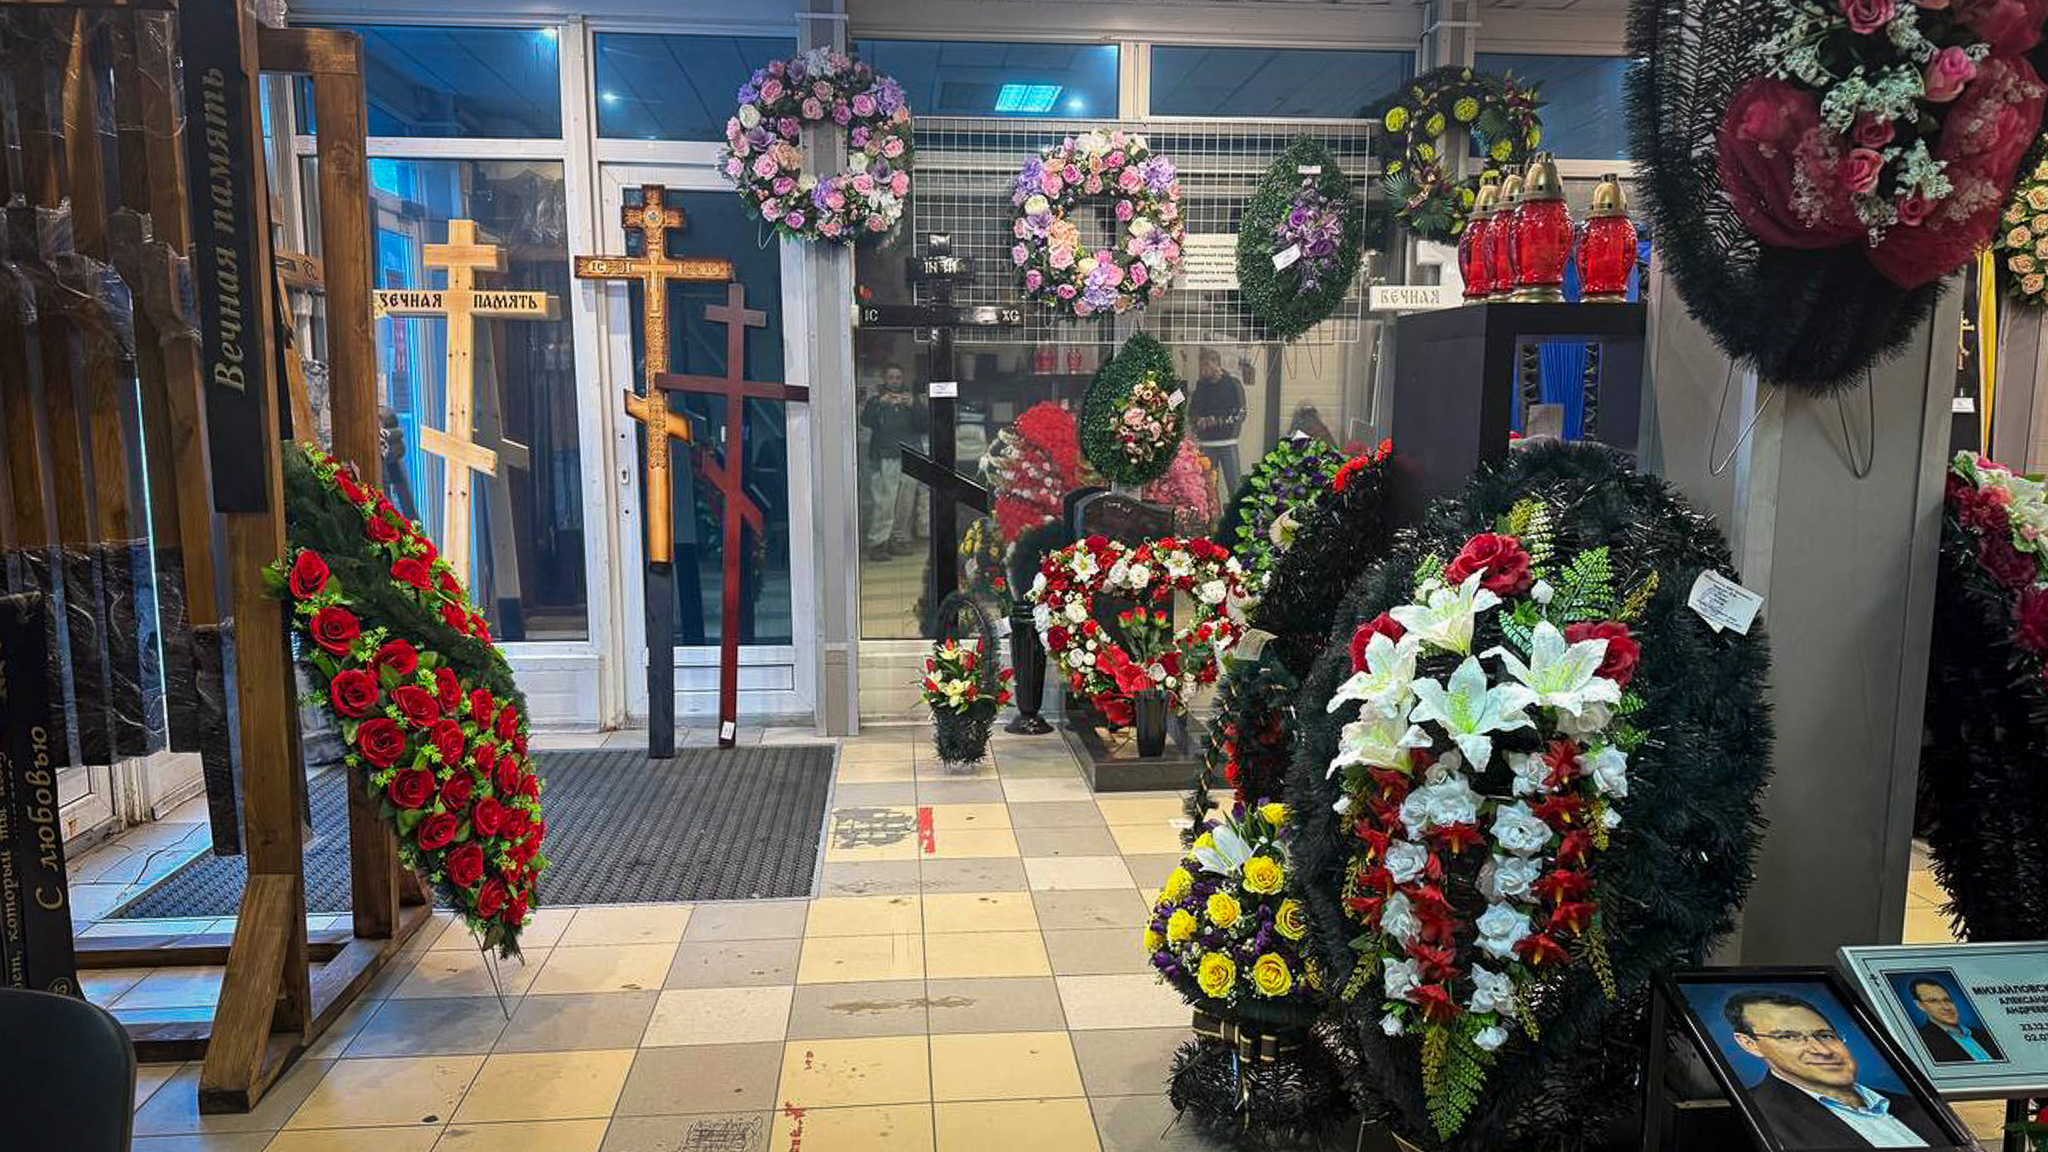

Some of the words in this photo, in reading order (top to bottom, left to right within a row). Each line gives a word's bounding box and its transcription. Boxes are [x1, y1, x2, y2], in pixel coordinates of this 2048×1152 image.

[203, 67, 235, 234] память
[214, 246, 245, 396] Вечная
[473, 293, 538, 310] ПАМЯТЬ
[1380, 289, 1440, 304] ВЕЧНАЯ
[25, 726, 58, 873] любовью
[35, 885, 63, 910] С
